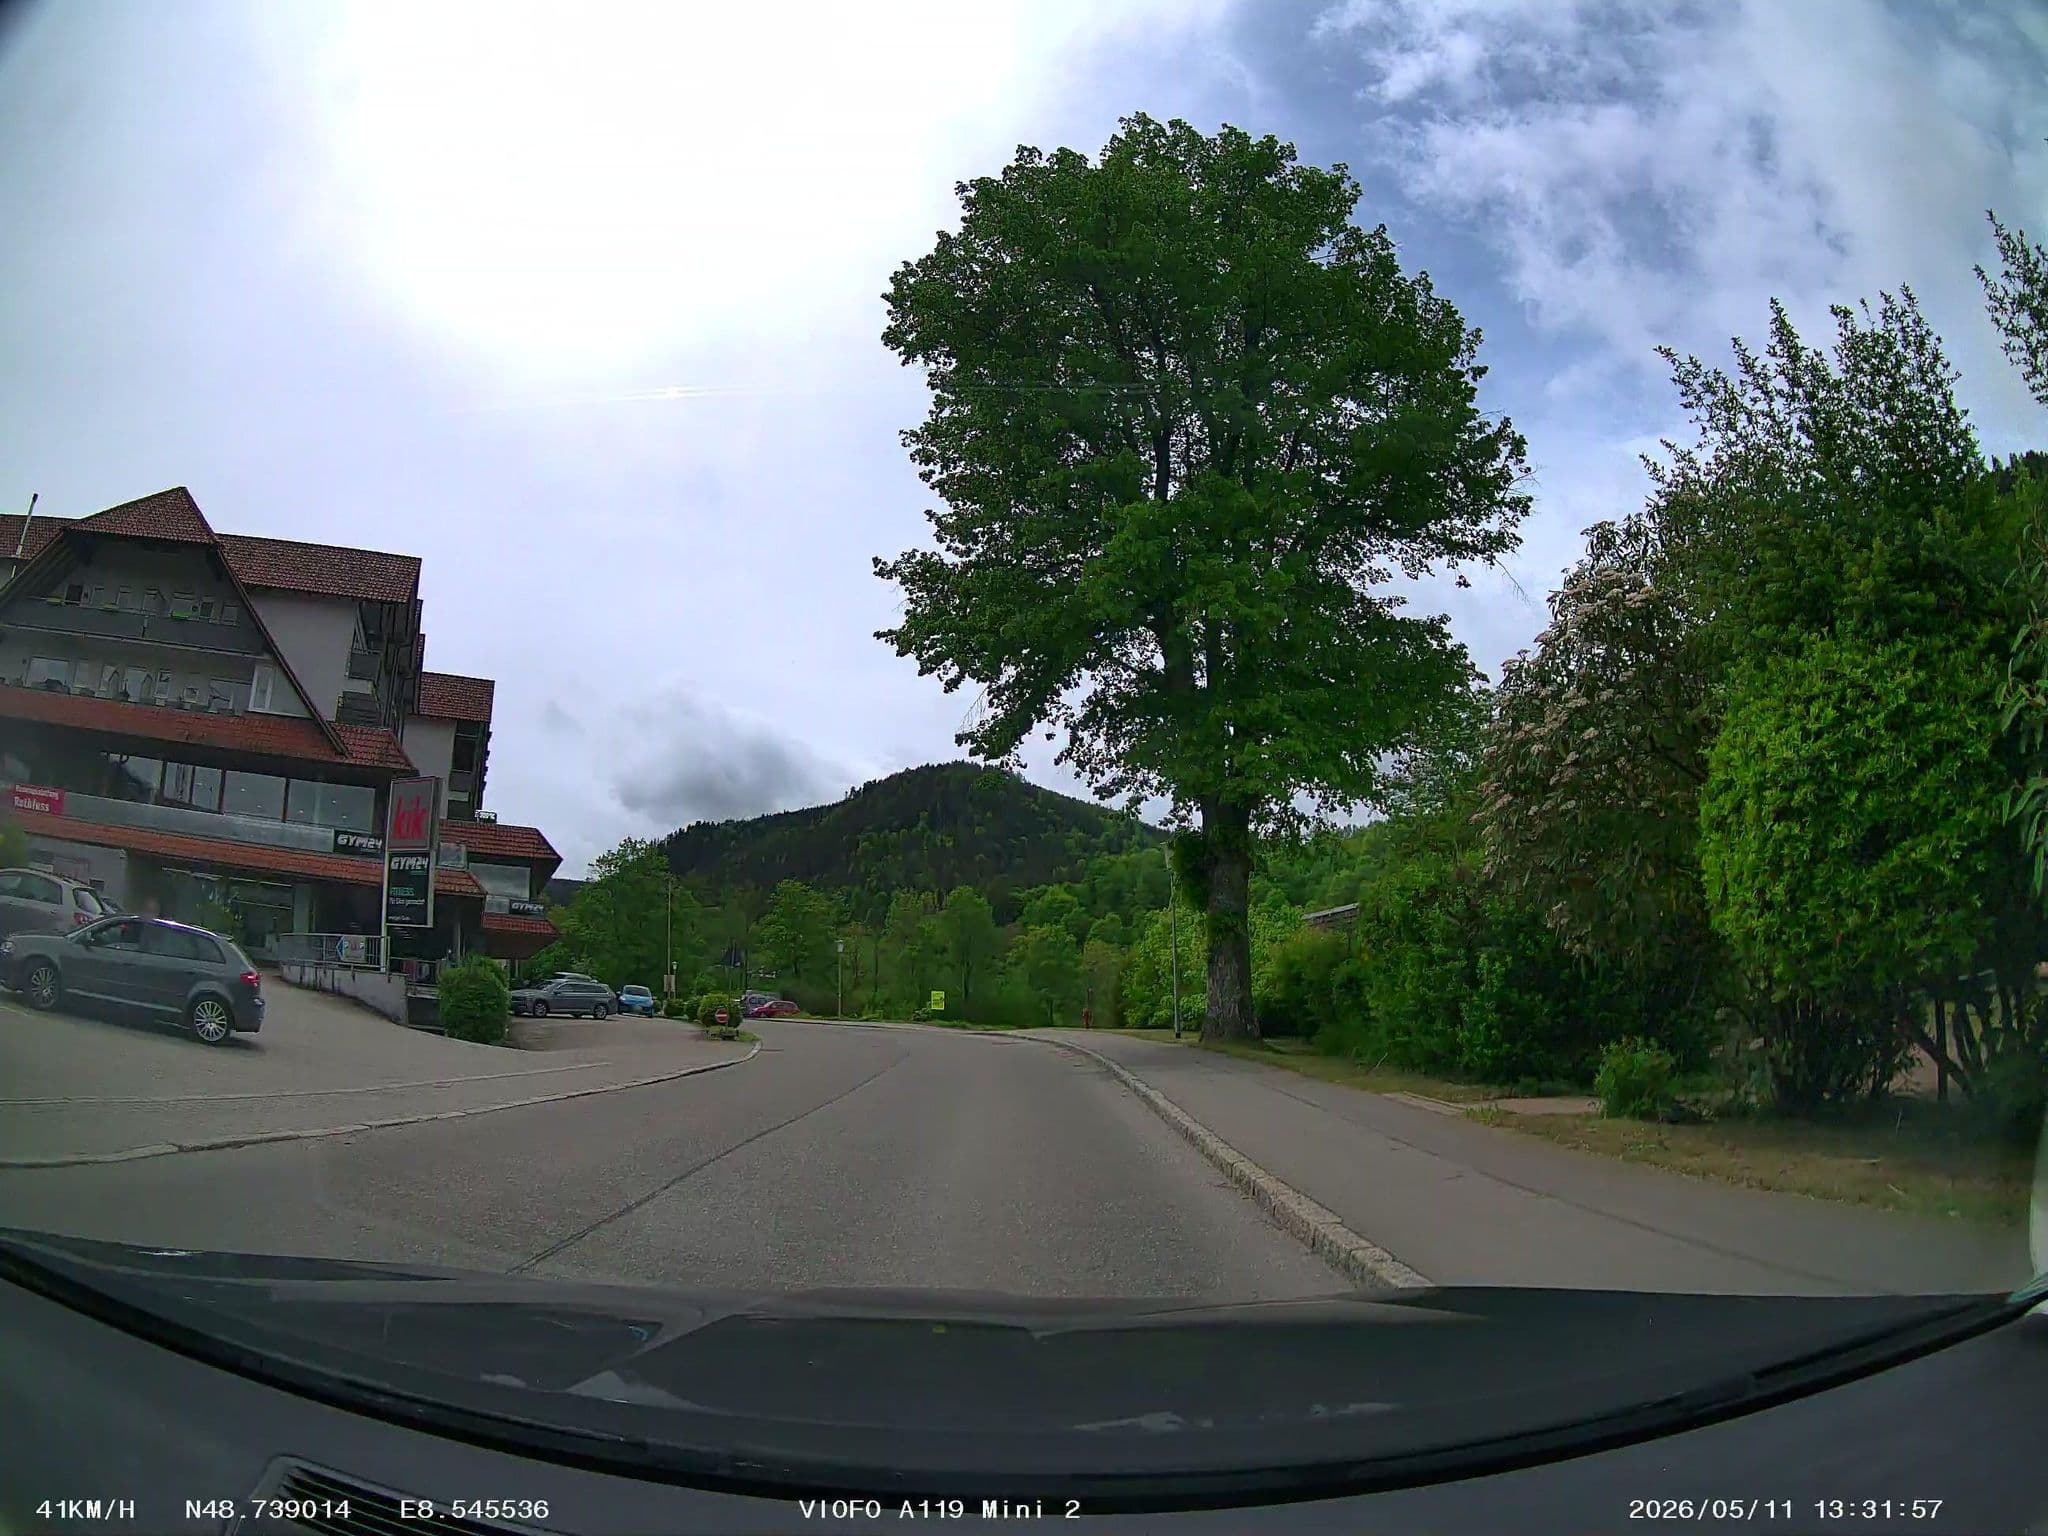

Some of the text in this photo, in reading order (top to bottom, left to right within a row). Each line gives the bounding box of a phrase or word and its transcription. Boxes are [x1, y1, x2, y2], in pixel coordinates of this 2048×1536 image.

[337, 834, 382, 849] GYM24
[391, 856, 428, 870] GYM24
[511, 902, 544, 912] GYM24
